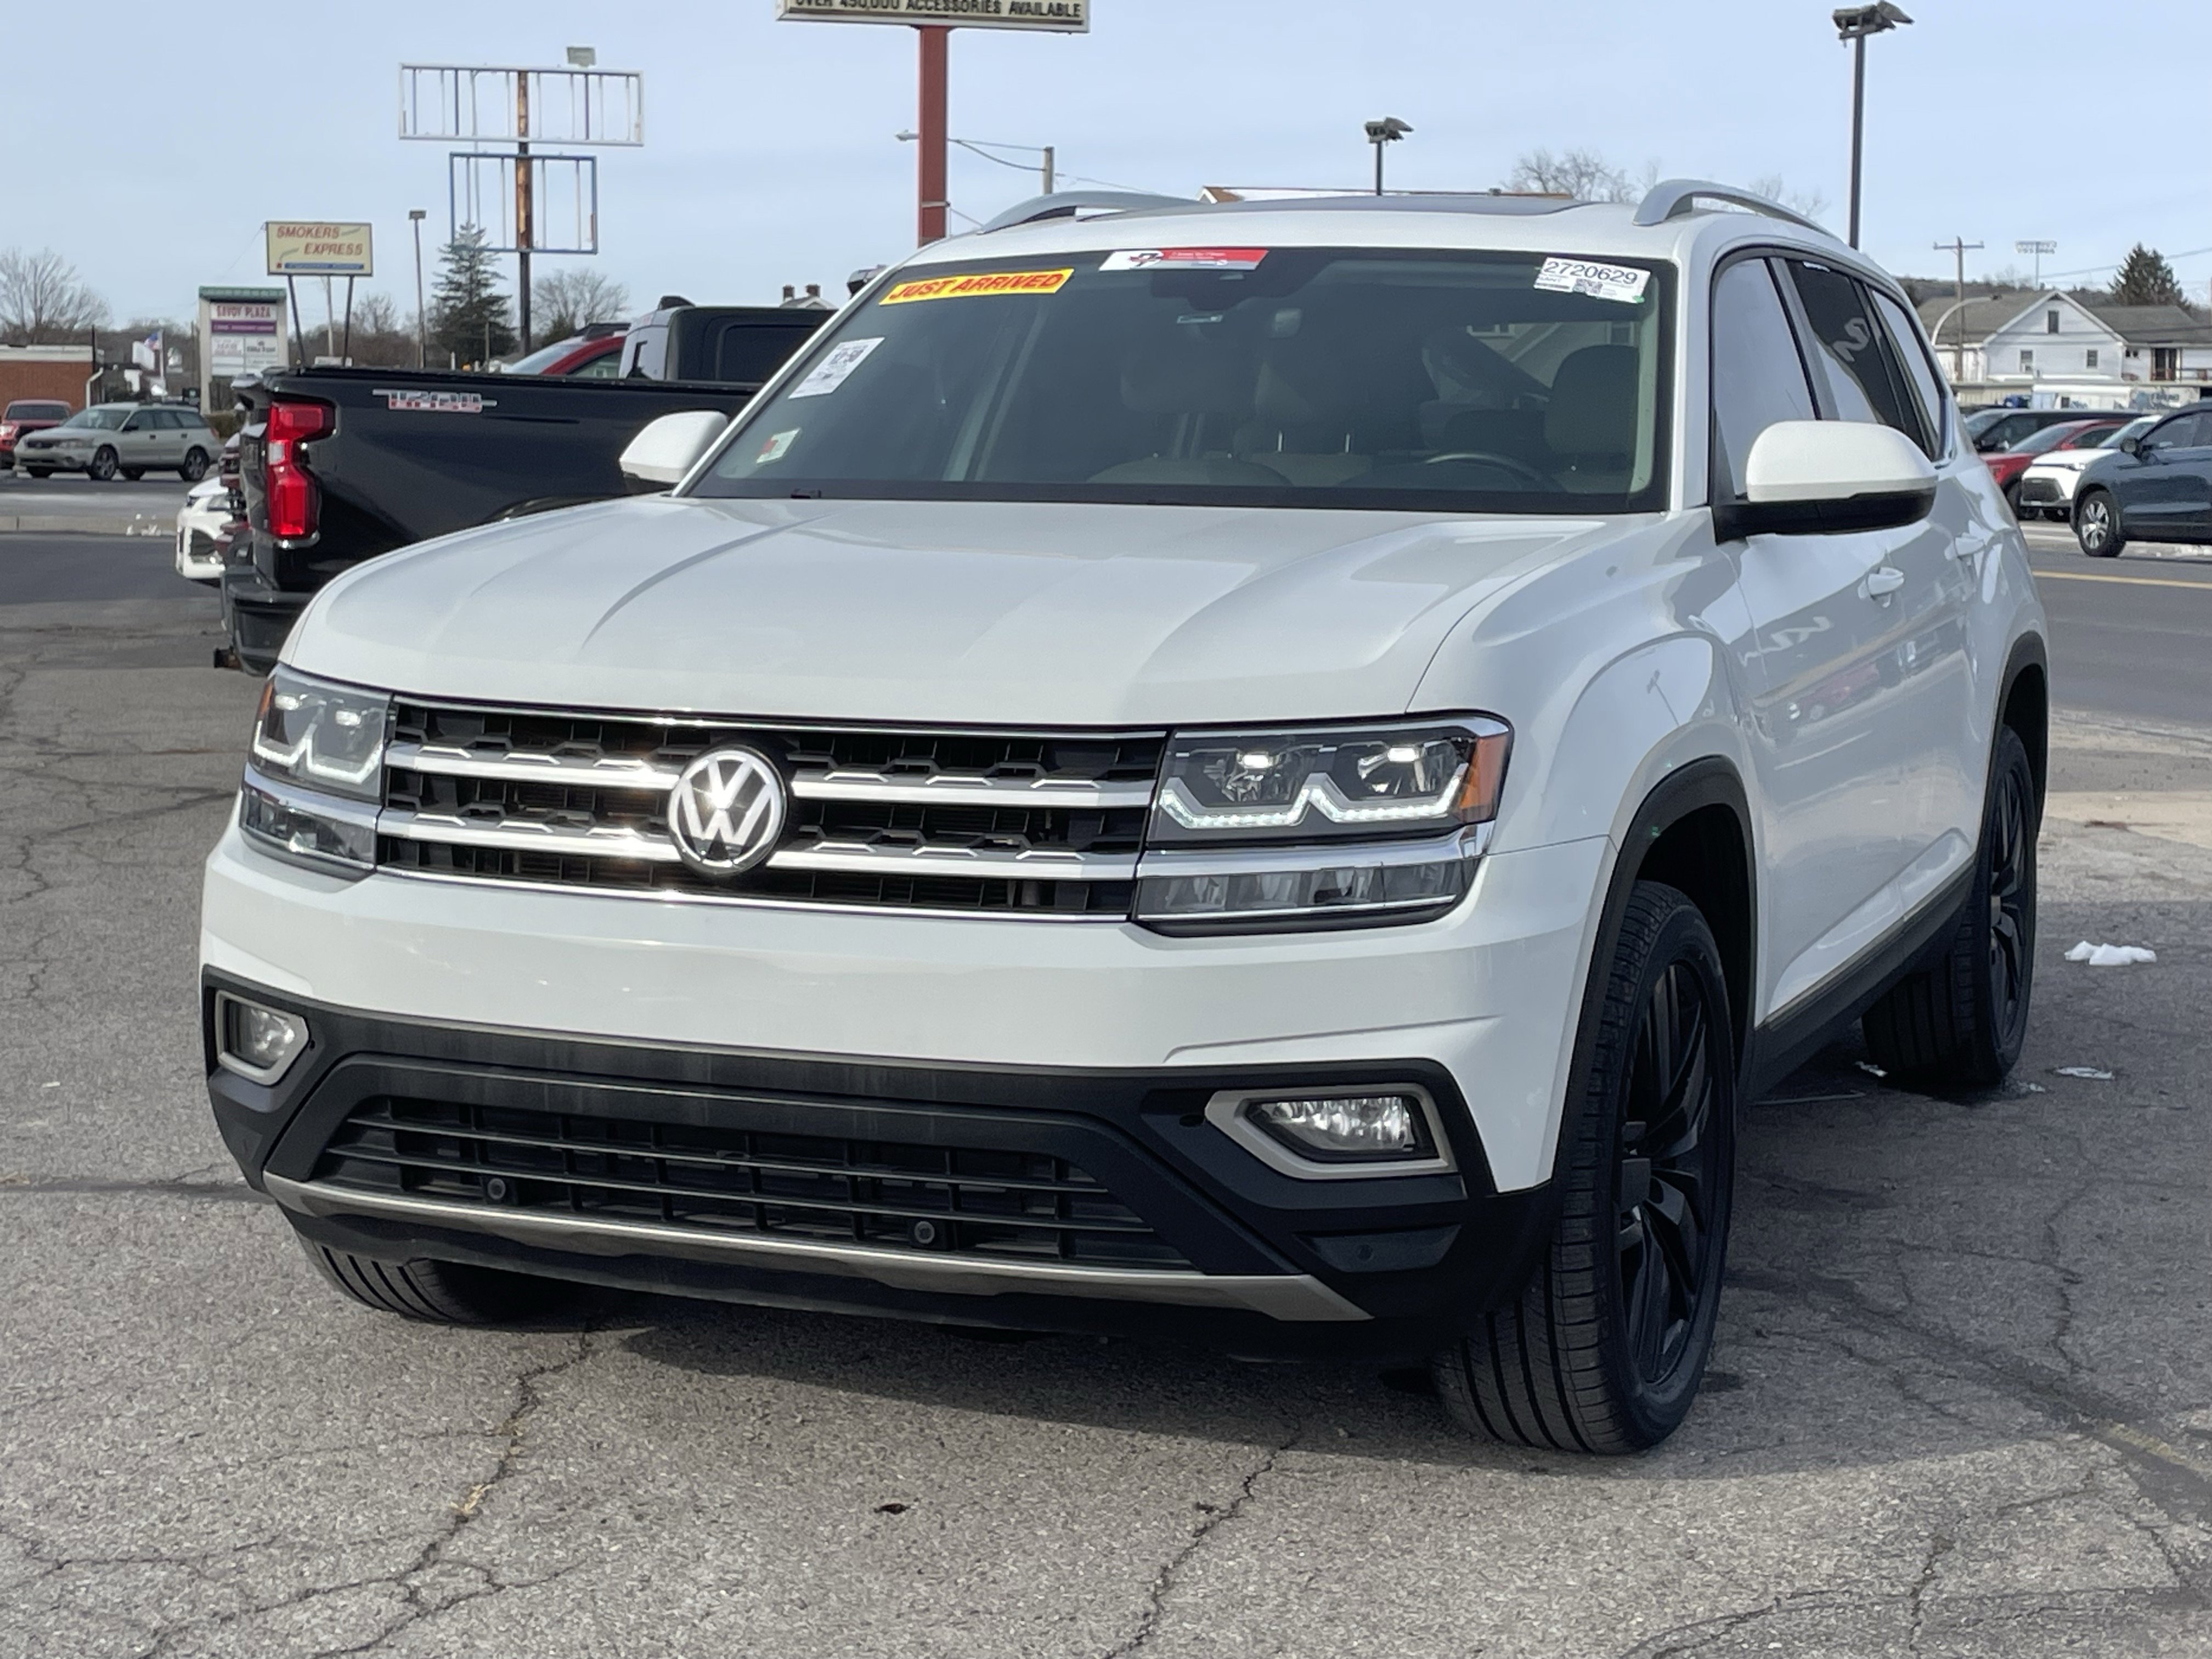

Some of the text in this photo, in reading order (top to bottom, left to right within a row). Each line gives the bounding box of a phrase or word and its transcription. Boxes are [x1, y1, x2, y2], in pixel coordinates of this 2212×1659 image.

[905, 0, 1001, 14] ACCESSORIES
[1009, 1, 1081, 17] AVAILABLE
[276, 225, 340, 239] SMOKERS
[303, 242, 363, 256] EXPRESS
[1543, 261, 1638, 285] 2720629
[888, 273, 1064, 300] JUST ARRIVED
